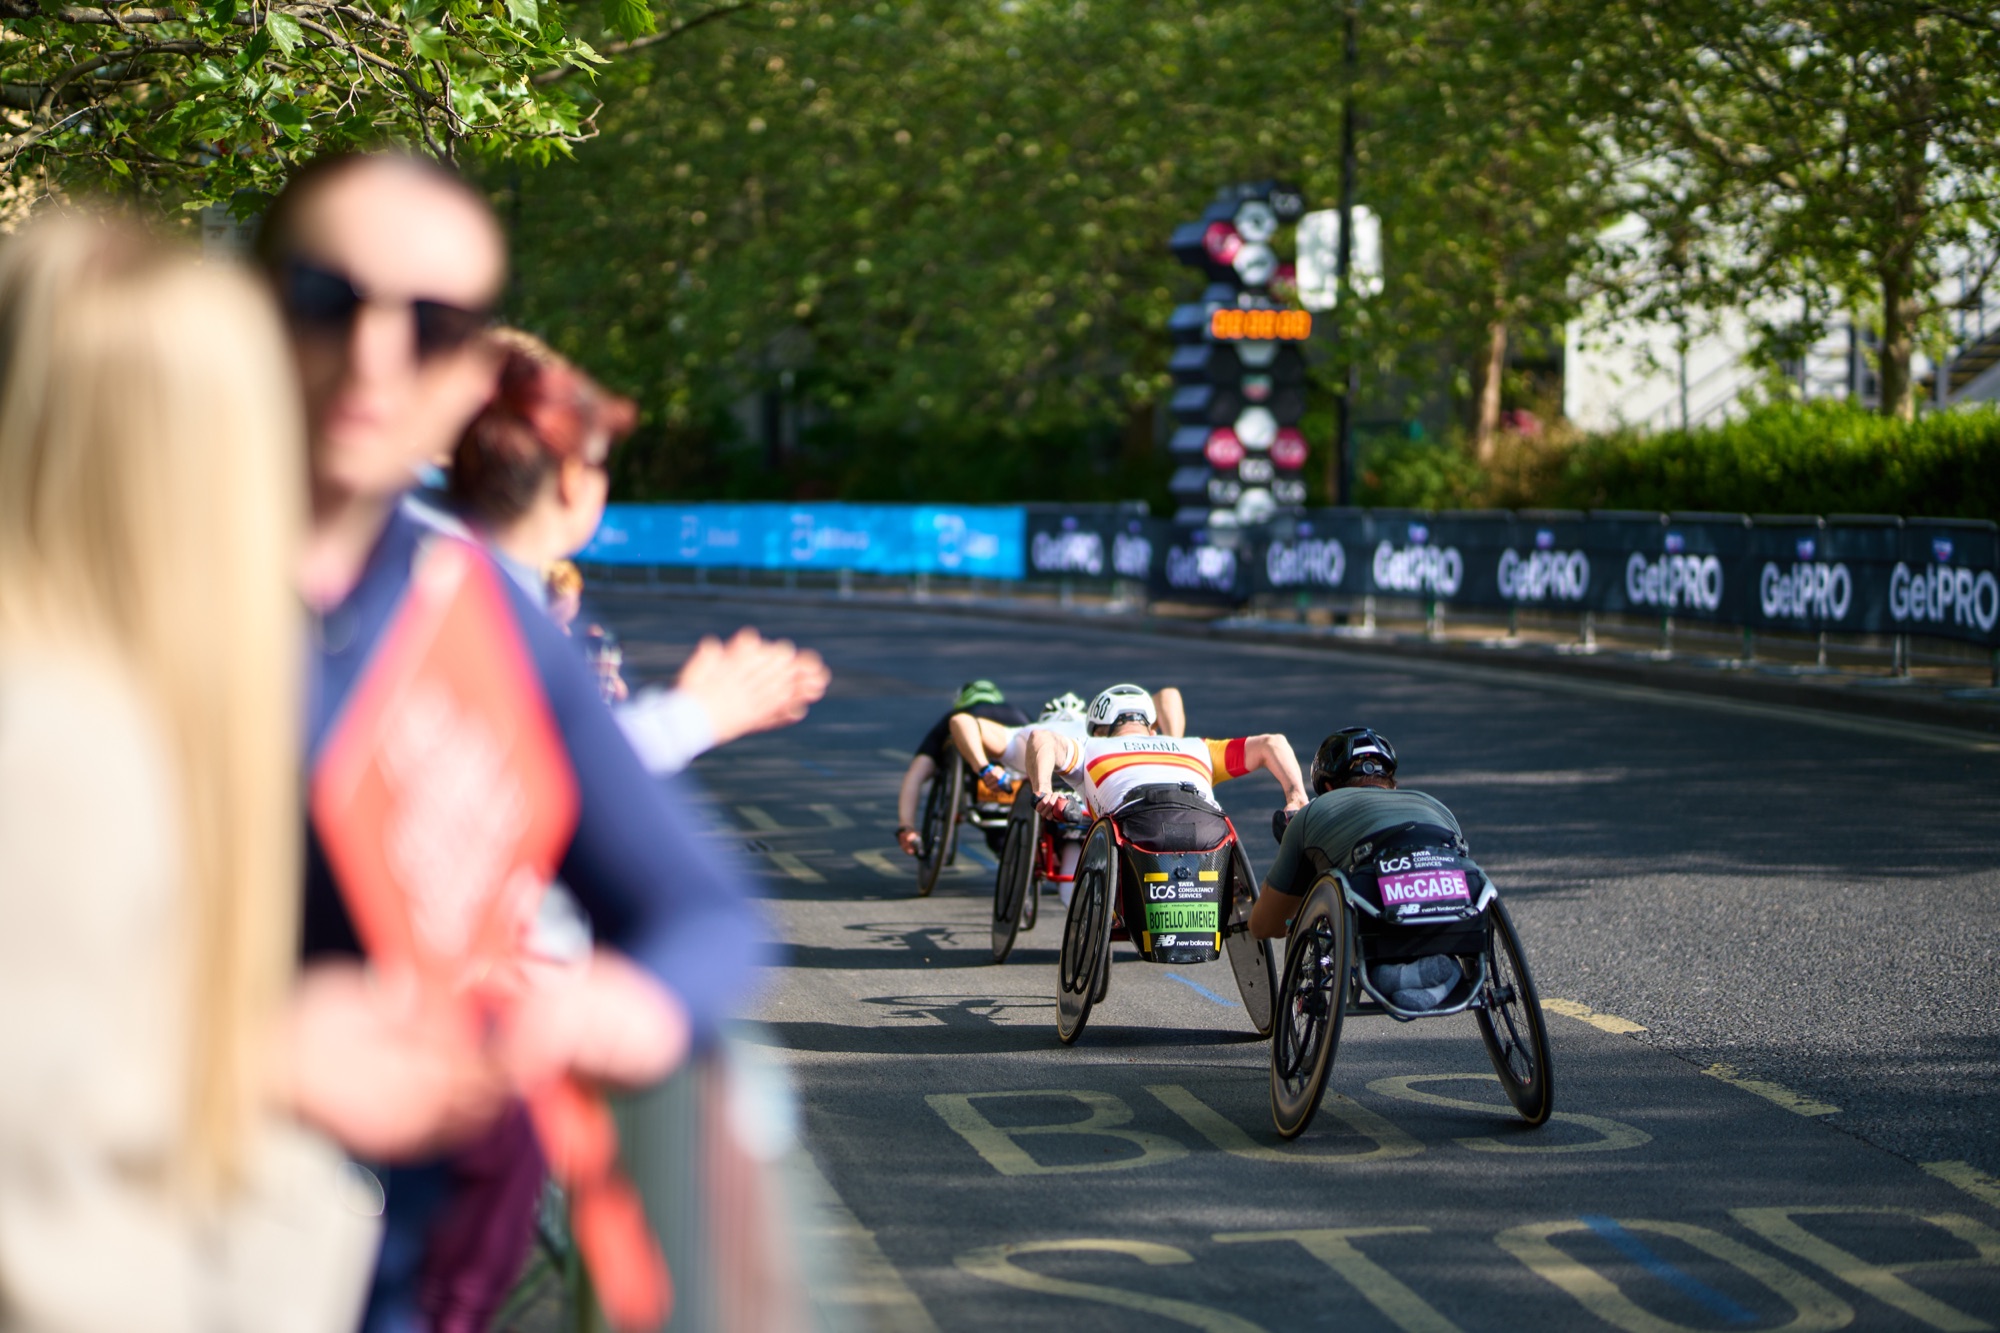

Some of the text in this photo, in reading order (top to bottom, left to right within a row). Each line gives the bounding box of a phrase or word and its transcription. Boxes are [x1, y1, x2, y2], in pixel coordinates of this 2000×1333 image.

[1497, 549, 1589, 600] GetPRO
[1626, 552, 1723, 612] GetPRO
[1760, 561, 1851, 620] GetPRO
[1889, 561, 2000, 632] GetPRO
[1124, 740, 1180, 752] ESPAÑA
[1384, 877, 1466, 900] McCABE
[1150, 911, 1215, 929] BOTELLO JIMENEZ
[924, 1072, 1654, 1176] BUS
